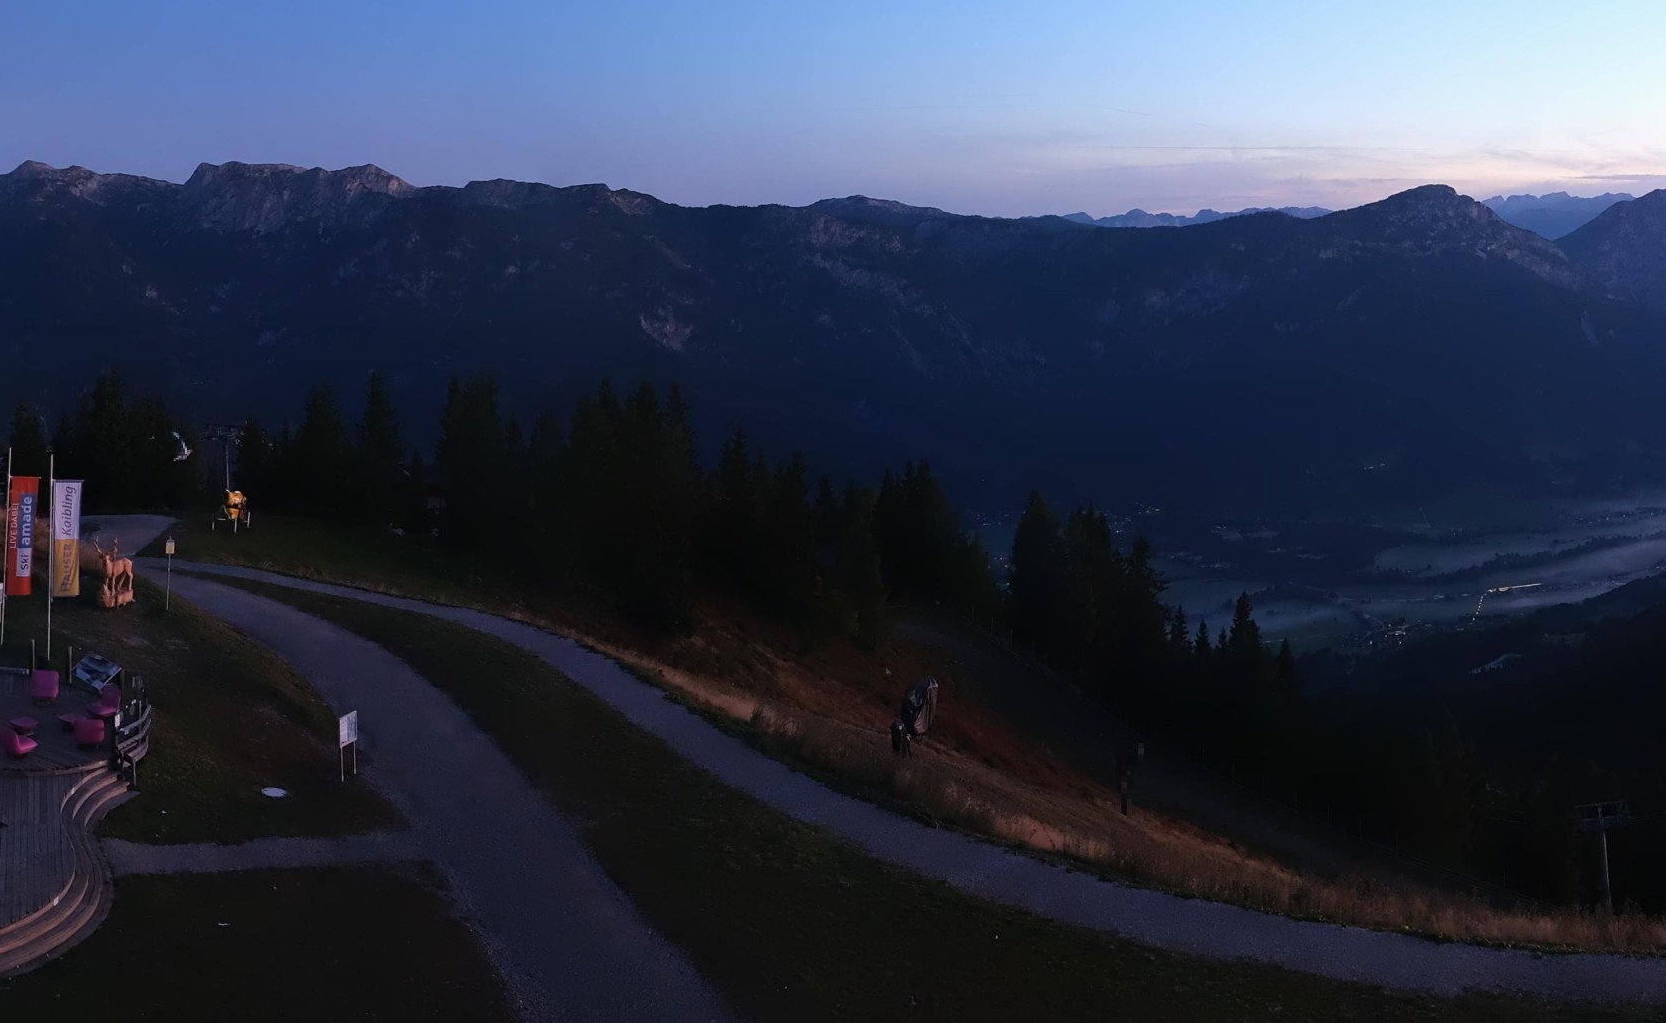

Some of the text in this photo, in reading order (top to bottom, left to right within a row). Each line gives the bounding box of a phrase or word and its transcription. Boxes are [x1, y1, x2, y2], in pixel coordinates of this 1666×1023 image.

[11, 503, 19, 528] DABEI
[61, 486, 76, 536] Kaibling
[20, 555, 30, 571] Ski
